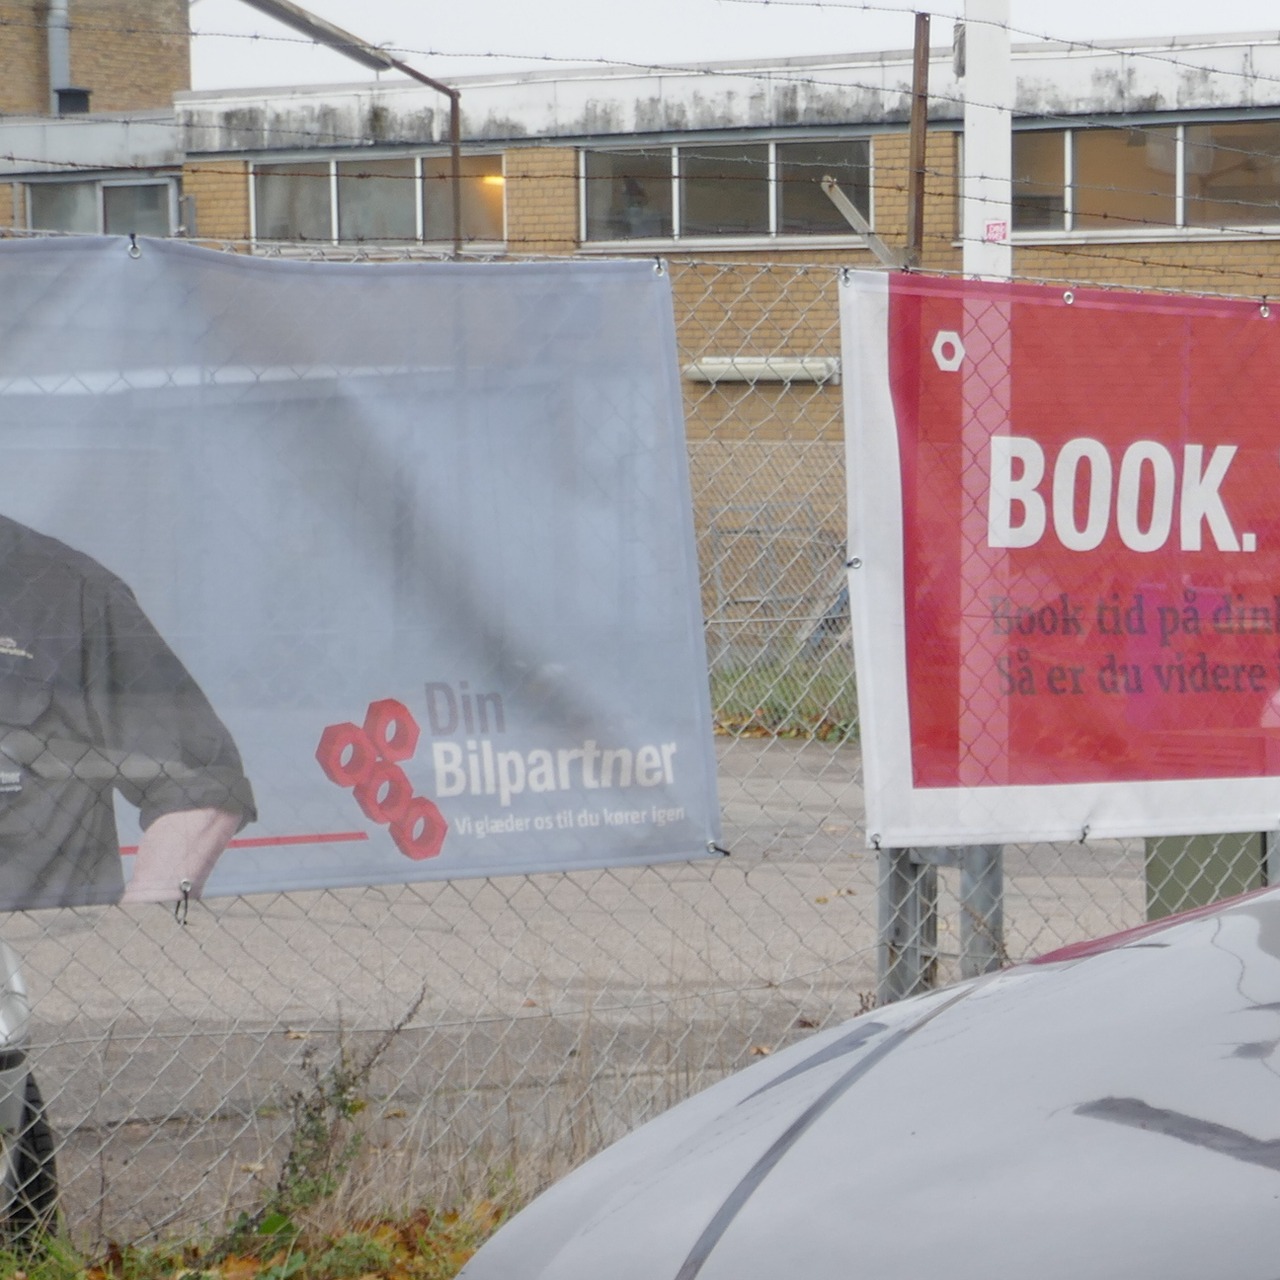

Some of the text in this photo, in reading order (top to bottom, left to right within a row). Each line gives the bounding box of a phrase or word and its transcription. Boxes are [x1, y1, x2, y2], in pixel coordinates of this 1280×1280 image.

[986, 435, 1256, 553] BOOK.
[989, 593, 1085, 636] Book
[1096, 593, 1147, 636] tid
[1157, 588, 1200, 647] på
[996, 648, 1037, 696] Så
[1046, 664, 1085, 695] er
[1097, 652, 1144, 695] du
[1153, 650, 1267, 695] videre
[424, 681, 507, 737] Din
[432, 739, 678, 807] Bilpartner
[455, 805, 685, 839] Vi glæder os til du kører igen
